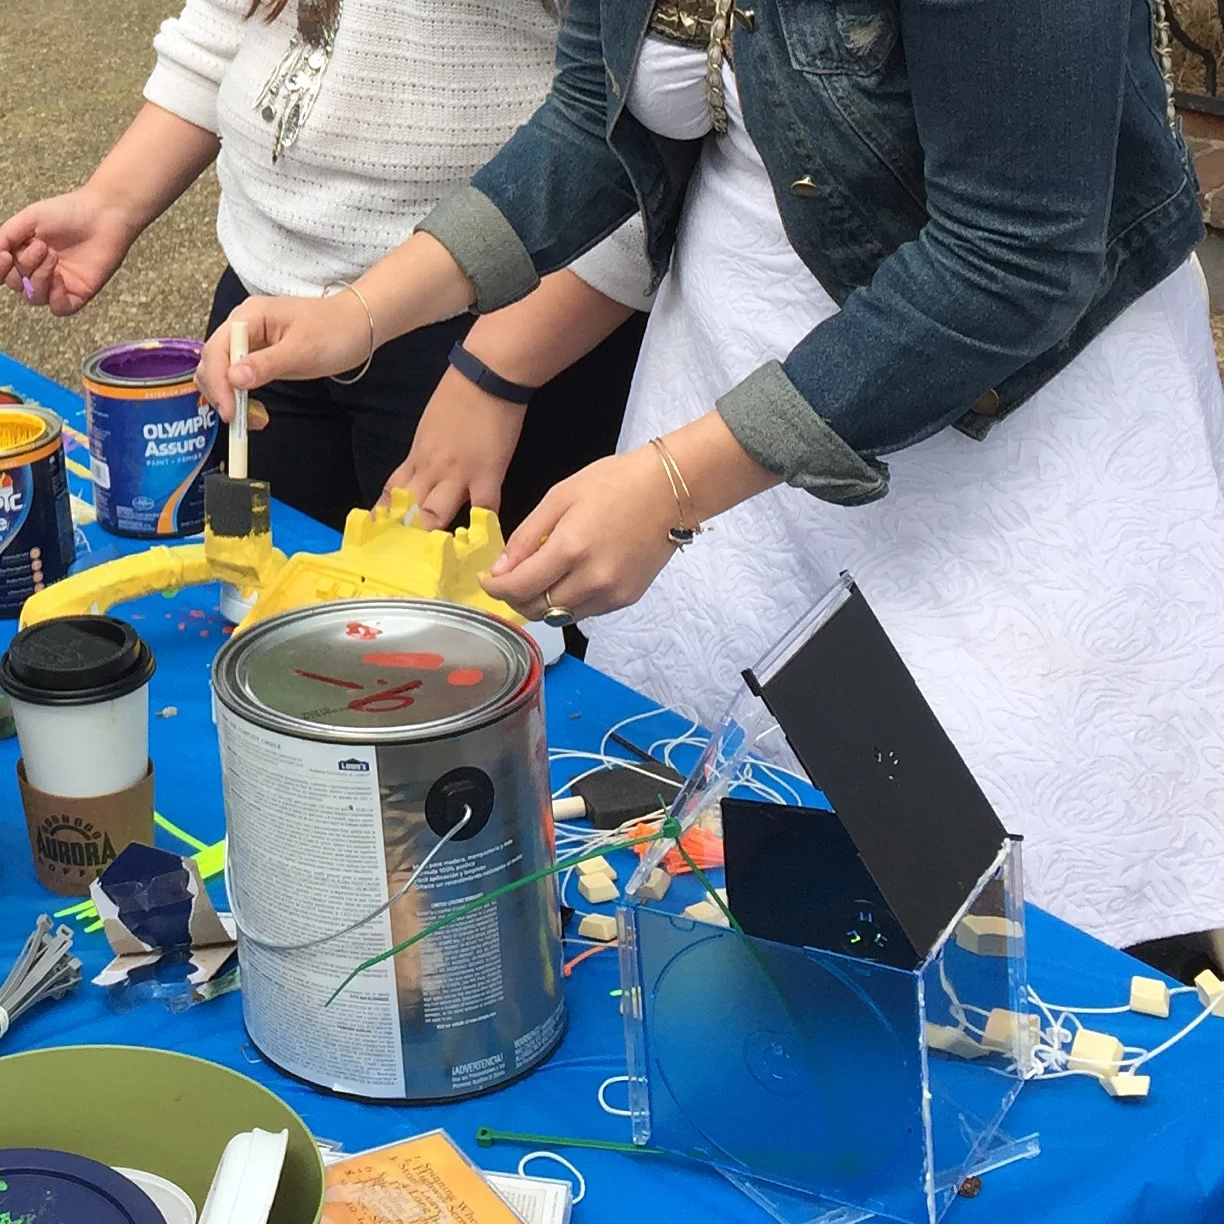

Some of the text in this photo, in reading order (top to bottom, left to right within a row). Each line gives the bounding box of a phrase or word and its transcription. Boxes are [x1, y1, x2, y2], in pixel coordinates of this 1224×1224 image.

[143, 409, 216, 439] OLYMPIC
[144, 435, 206, 457] Assure
[38, 856, 104, 878] COFFE
